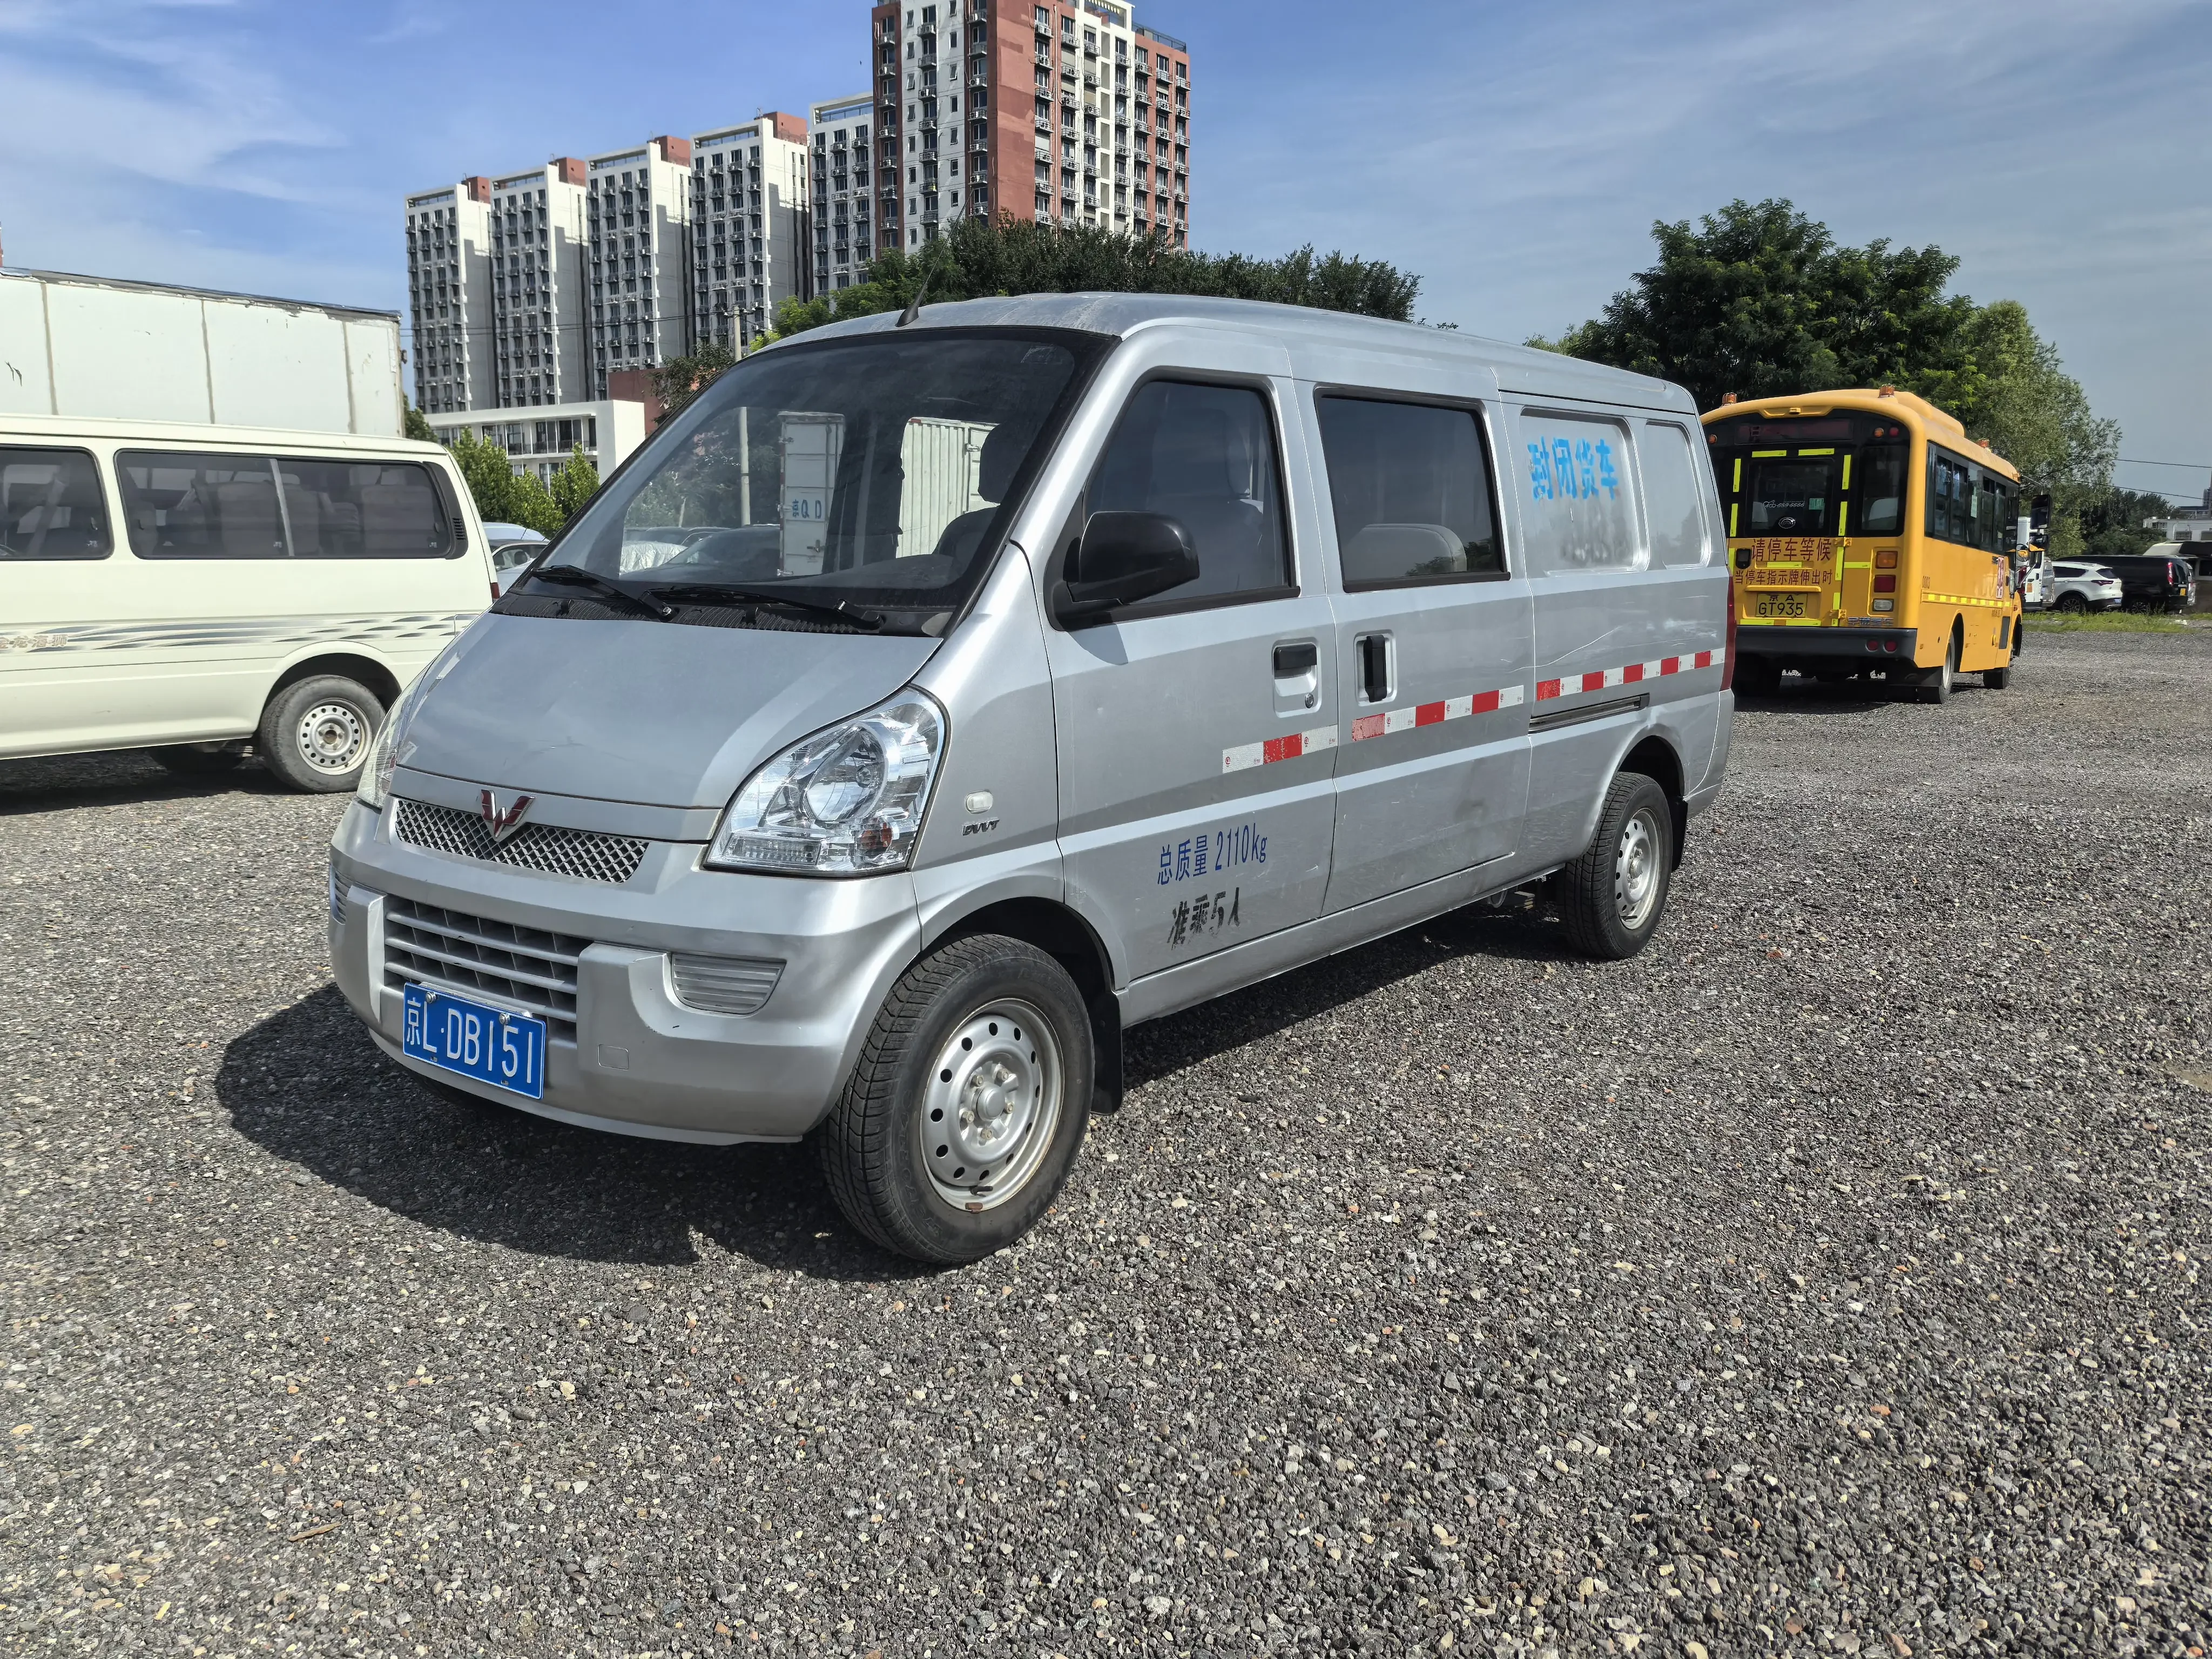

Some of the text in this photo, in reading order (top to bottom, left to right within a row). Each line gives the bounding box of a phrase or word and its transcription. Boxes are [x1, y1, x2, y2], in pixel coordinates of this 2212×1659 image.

[1752, 538, 1832, 561] 请停车等候
[1735, 569, 1832, 585] 当停车指示牌伸出时
[1759, 602, 1804, 615] GT935
[1157, 822, 1267, 885] 总质量 2110kg
